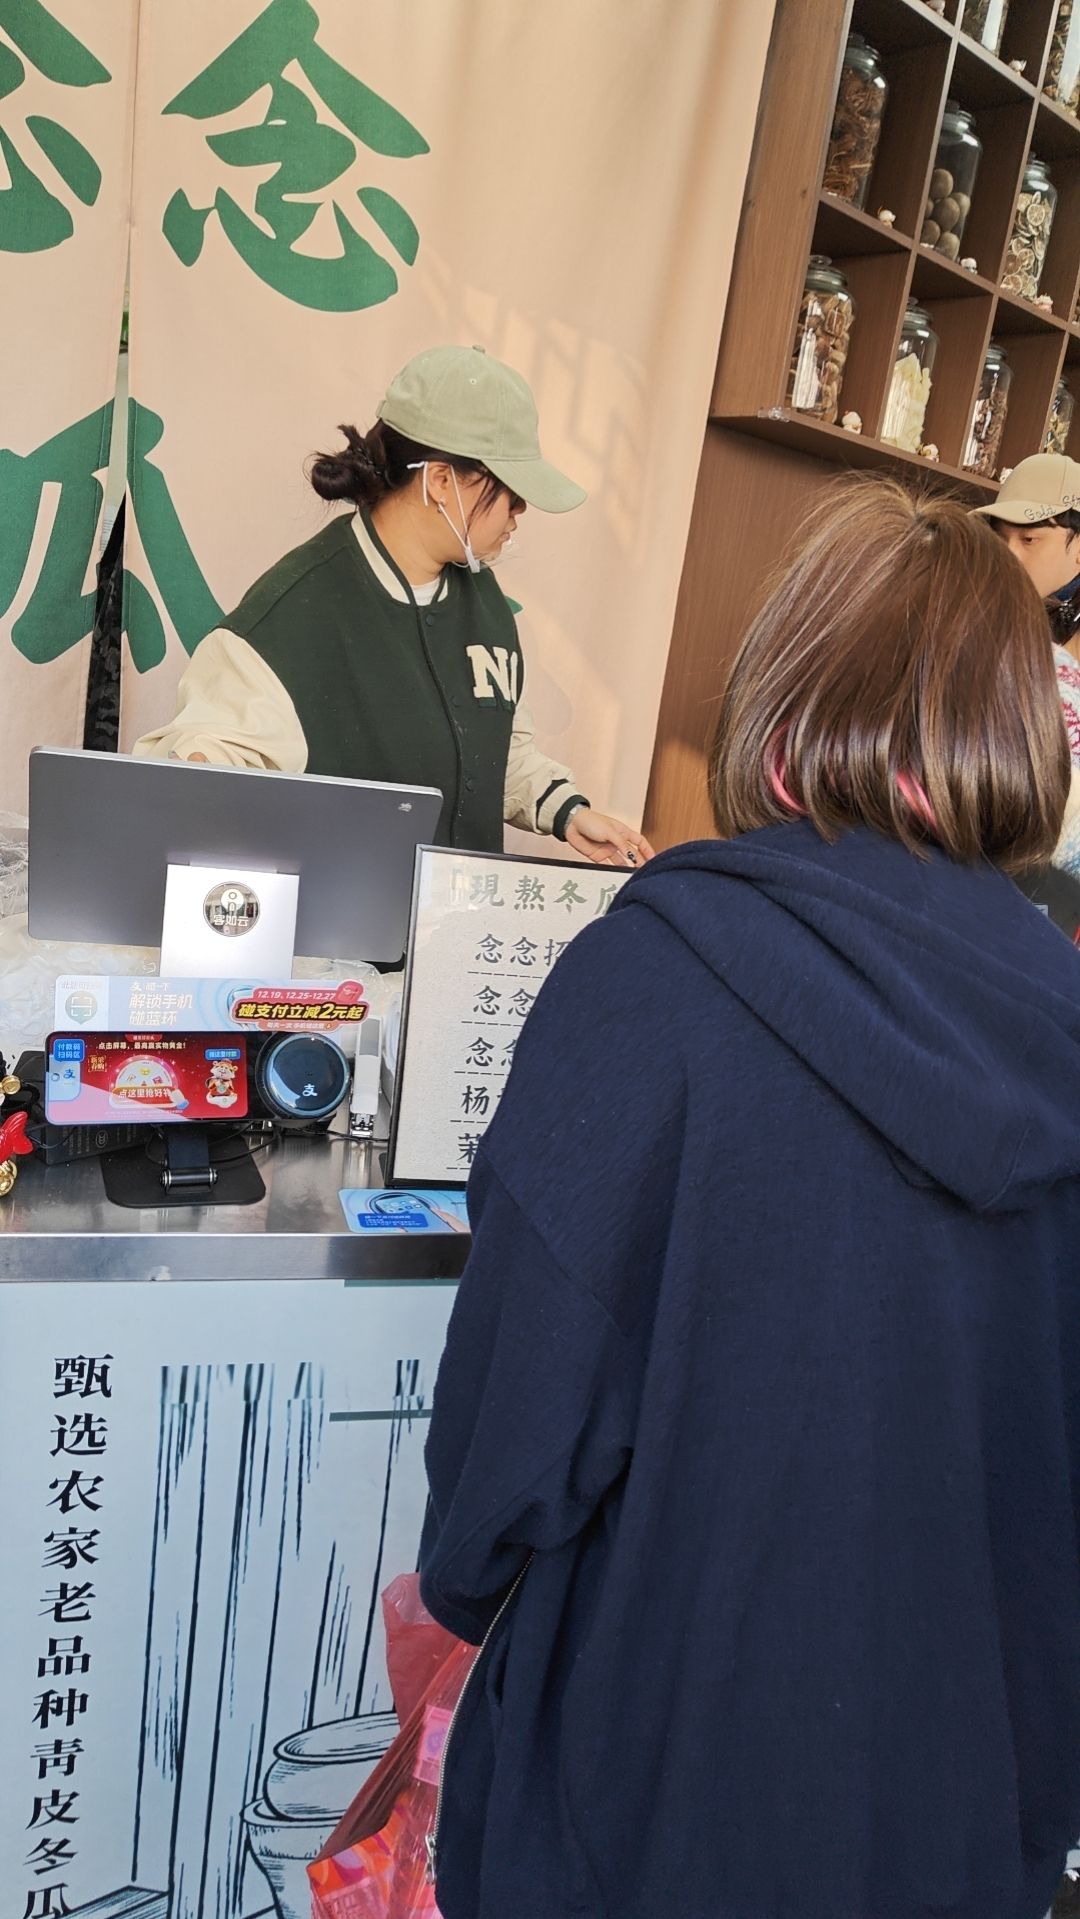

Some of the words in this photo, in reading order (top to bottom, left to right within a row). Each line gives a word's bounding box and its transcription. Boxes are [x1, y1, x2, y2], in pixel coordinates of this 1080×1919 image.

[466, 644, 518, 704] N
[213, 914, 249, 927] 客如云
[129, 993, 193, 1009] 解锁手机
[473, 985, 536, 1017] 念念
[129, 1010, 178, 1026] 碰蓝环
[238, 1003, 364, 1020] 碰支付立减2元起
[57, 1042, 81, 1051] 付款码
[57, 1051, 81, 1059] 扫码区
[461, 1085, 504, 1116] 杨
